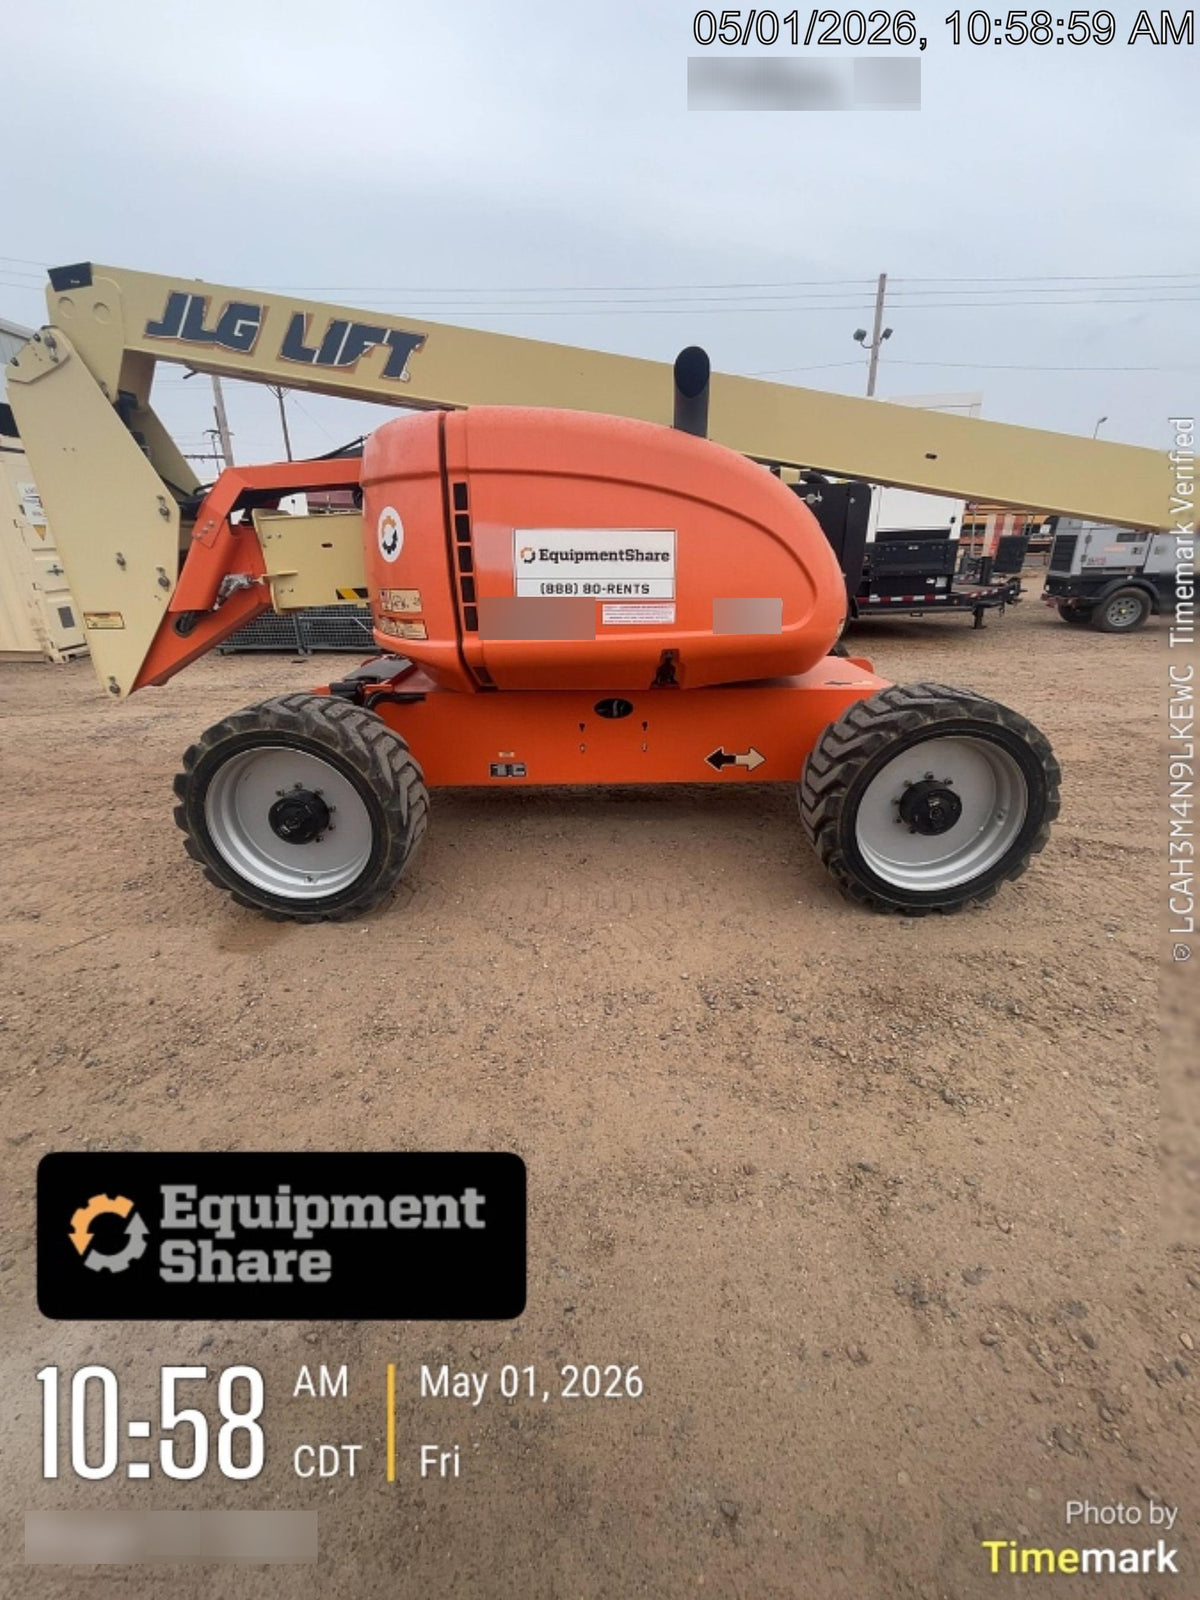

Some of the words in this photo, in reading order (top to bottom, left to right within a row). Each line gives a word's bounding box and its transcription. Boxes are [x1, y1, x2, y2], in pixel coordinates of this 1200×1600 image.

[144, 290, 268, 356] JLG
[276, 310, 428, 382] LIFT
[538, 548, 670, 564] EquipmentShare
[540, 582, 579, 595] (888)
[582, 583, 650, 595] 80-RENTS
